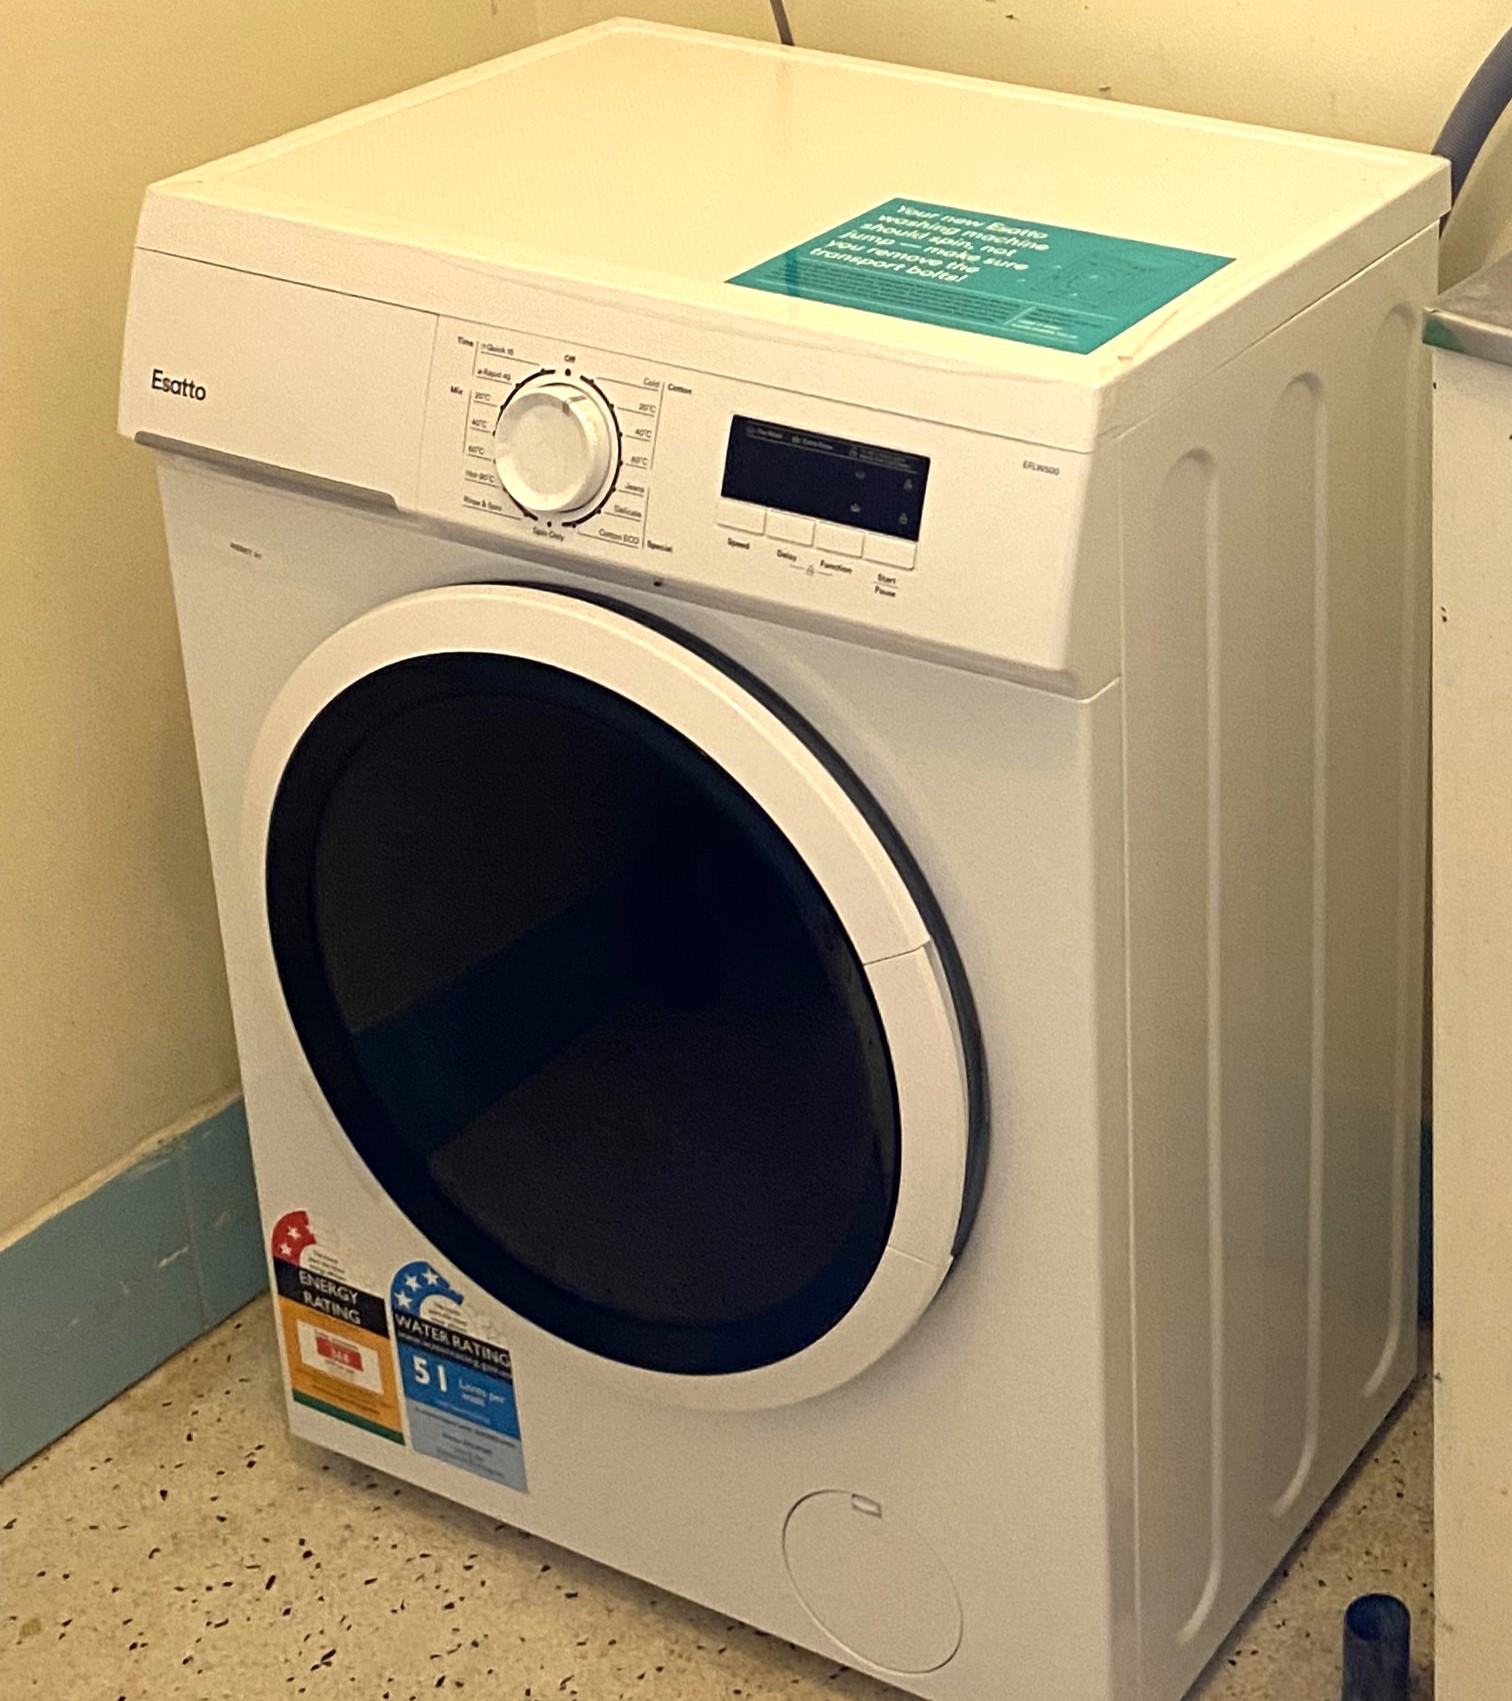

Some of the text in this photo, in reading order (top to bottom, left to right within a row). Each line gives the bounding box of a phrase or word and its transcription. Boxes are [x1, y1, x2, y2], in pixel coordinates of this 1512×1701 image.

[879, 215, 1049, 250] washing machine
[897, 205, 1048, 239] Your new Esatto
[825, 240, 980, 273] you remove the
[838, 229, 896, 245] jump
[923, 246, 981, 261] make
[983, 257, 1029, 270] sure
[861, 223, 1017, 257] should spin, not
[810, 248, 968, 283] transport bolts!
[150, 368, 207, 401] Esatto
[667, 383, 693, 395] Cotton
[727, 537, 750, 550] Speed
[776, 549, 797, 562] Delay
[820, 559, 853, 574] Function
[877, 573, 896, 584] Start
[874, 585, 896, 598] Pause
[299, 1270, 358, 1304] ENERGY
[303, 1290, 361, 1325] RATING
[395, 1313, 450, 1346] WATER
[452, 1334, 511, 1368] RATING
